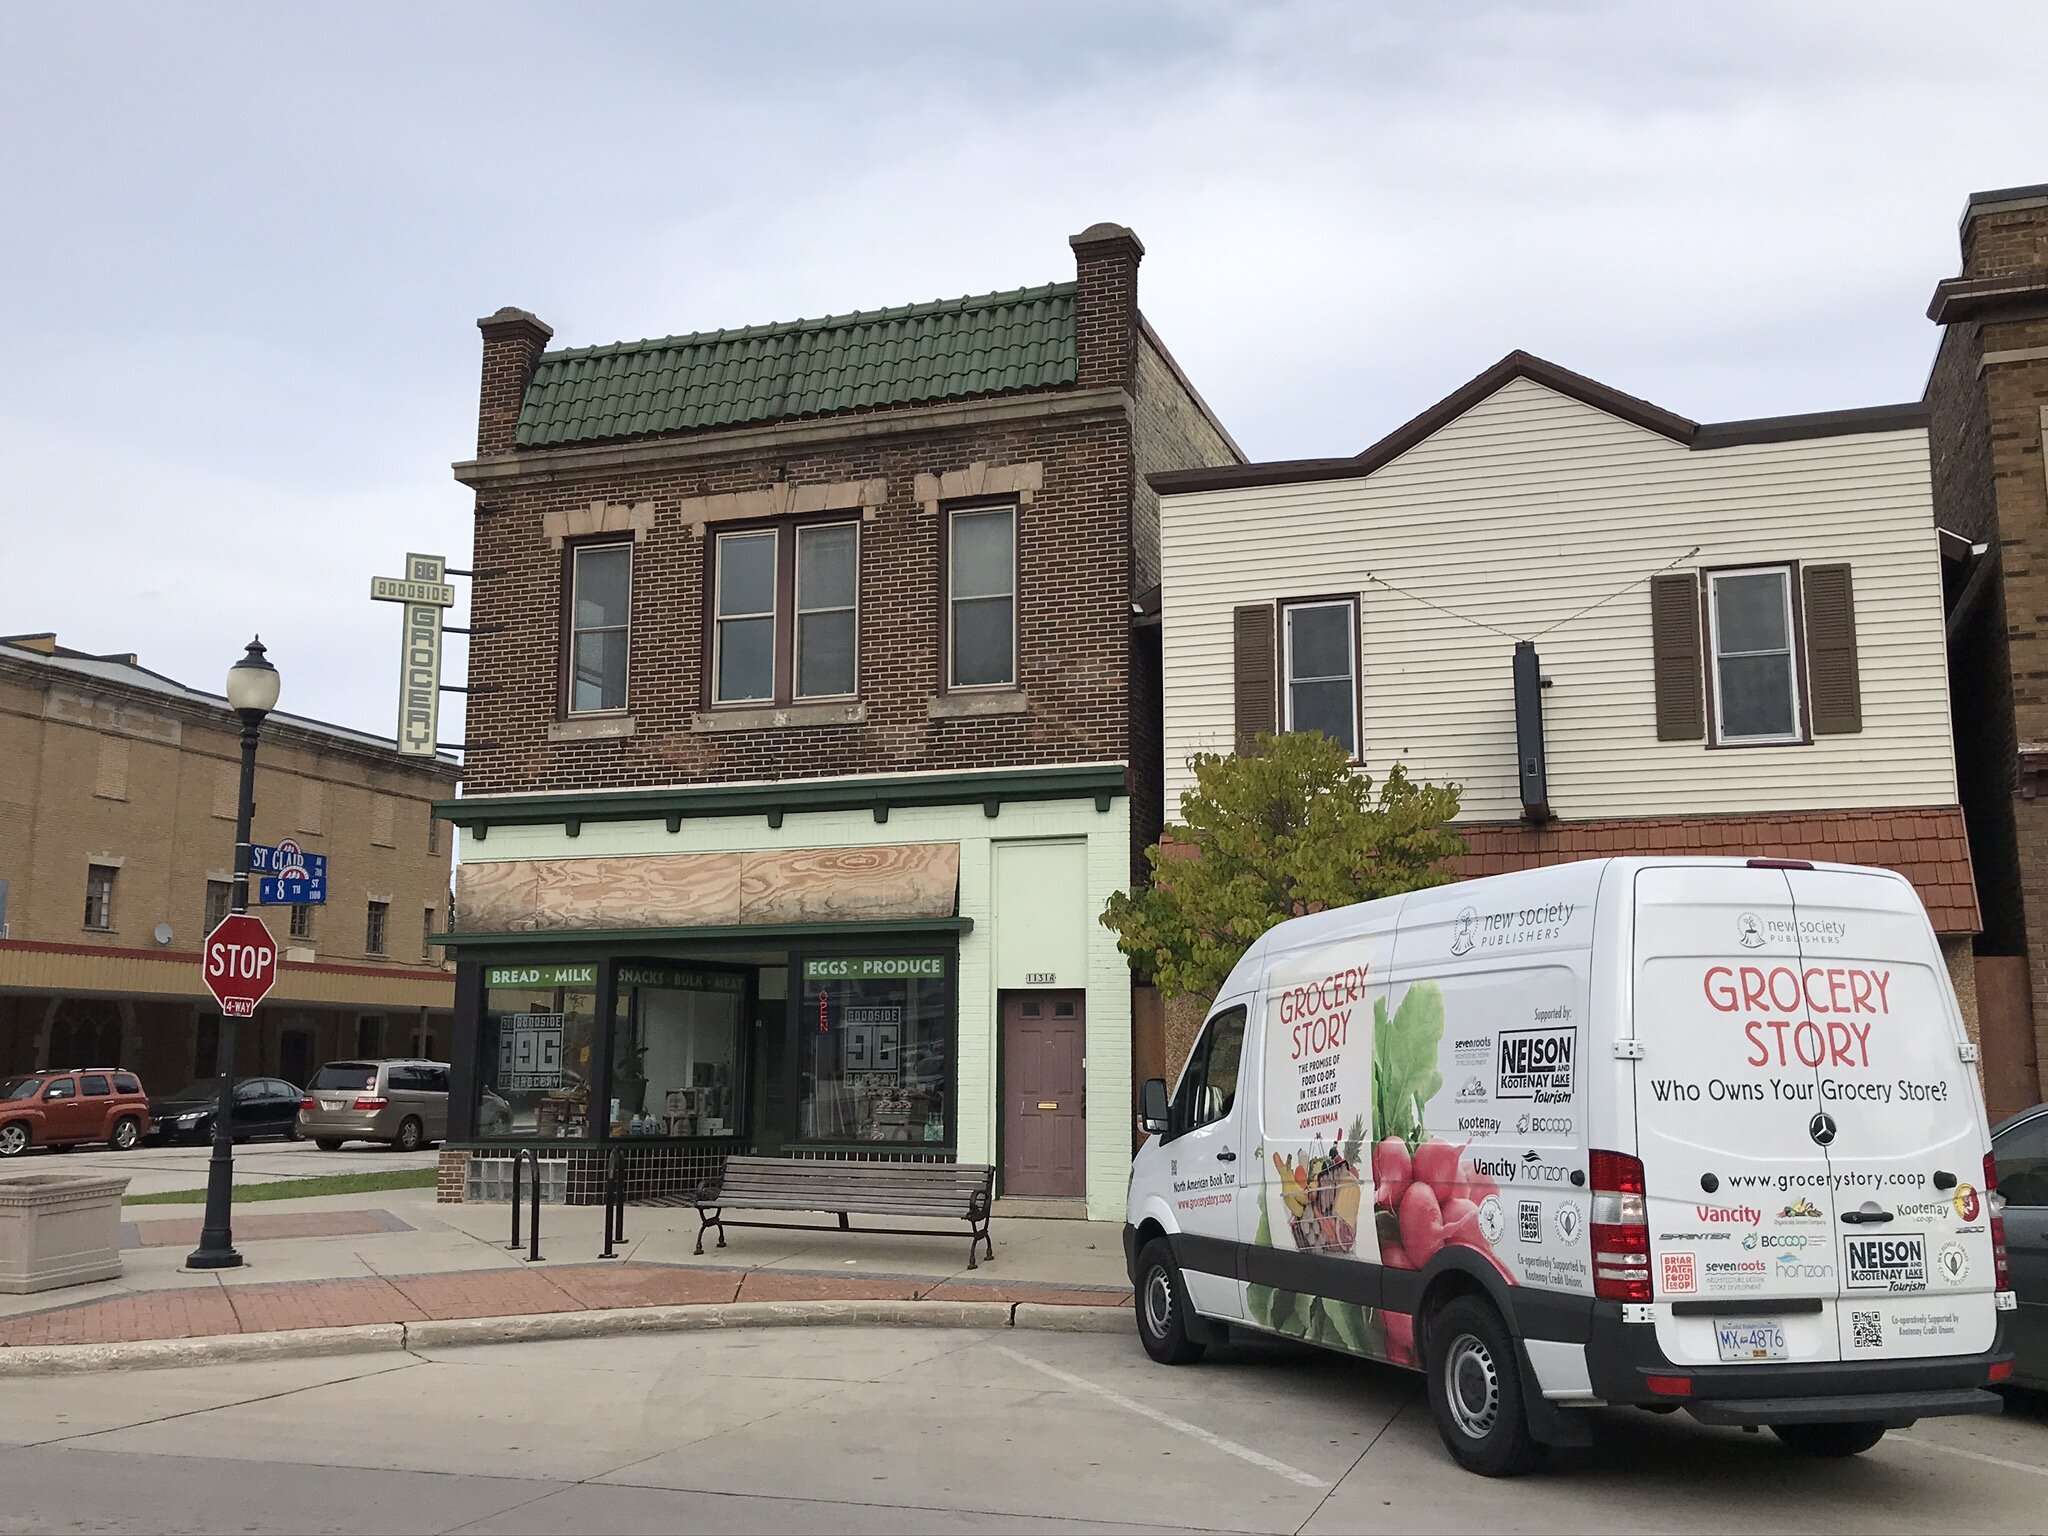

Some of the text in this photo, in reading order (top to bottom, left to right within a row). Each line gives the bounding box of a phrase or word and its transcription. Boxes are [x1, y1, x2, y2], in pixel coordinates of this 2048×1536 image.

[406, 607, 436, 750] GROCERY
[253, 847, 268, 868] ST
[264, 879, 319, 900] N 8 TH ST
[1484, 902, 1574, 931] new society
[1481, 927, 1560, 947] PUBLISHERS
[1768, 920, 1846, 937] new society
[1770, 934, 1840, 944] PUBLISHERS
[209, 942, 272, 979] STOP
[808, 959, 940, 975] EGGS PRODUCE
[492, 968, 592, 984] BREAD MILK
[618, 968, 663, 985] SNACKS
[674, 973, 703, 987] BULK
[1280, 963, 1369, 1024] GROCERY
[1703, 966, 1890, 1015] GROCERY
[226, 1001, 251, 1013] 4-WAY
[819, 990, 829, 1033] OPEN
[848, 1010, 898, 1021] GOODSIDE
[1534, 1005, 1561, 1022] Supported
[1291, 1008, 1352, 1060] STORY
[1744, 1020, 1871, 1068] STORY
[1298, 1054, 1340, 1075] THE PROMISE OF
[1501, 1036, 1572, 1074] NELSON
[1301, 1068, 1336, 1087] FOOD CO-OPS
[1557, 1064, 1570, 1072] AND
[1300, 1081, 1337, 1100] IN THE AGE OF
[1501, 1073, 1570, 1089] KOOTENAY LAKE
[1651, 1078, 1947, 1103] Who Owns Your Grocery Store?
[1296, 1094, 1341, 1114] GROCERY GIANTS
[1533, 1089, 1572, 1104] Tourism
[1300, 1111, 1339, 1129] JON STEINMAN
[1458, 1116, 1502, 1134] Kootenay
[1473, 1157, 1516, 1182] Vancity
[1173, 1172, 1235, 1193] North American Book Tour
[1728, 1171, 1926, 1191] www.grocerystory.coop
[1696, 1204, 1762, 1227] Vancity
[1897, 1203, 1949, 1220] Kootenay
[1659, 1232, 1732, 1241] SPRINTER
[1664, 1256, 1692, 1265] BRIAR
[1850, 1240, 1922, 1269] NELSON
[1552, 1257, 1579, 1273] Supported
[1579, 1259, 1586, 1275] by
[1665, 1265, 1693, 1274] PATCH
[1851, 1268, 1923, 1281] KOOTENAY LAKE
[1525, 1269, 1583, 1288] Kootenay Credit Unions
[1666, 1273, 1690, 1282] FOOD
[1888, 1280, 1926, 1292] Tourism
[1928, 1313, 1952, 1325] Supported
[1952, 1312, 1959, 1324] by
[1923, 1325, 1938, 1335] Credit
